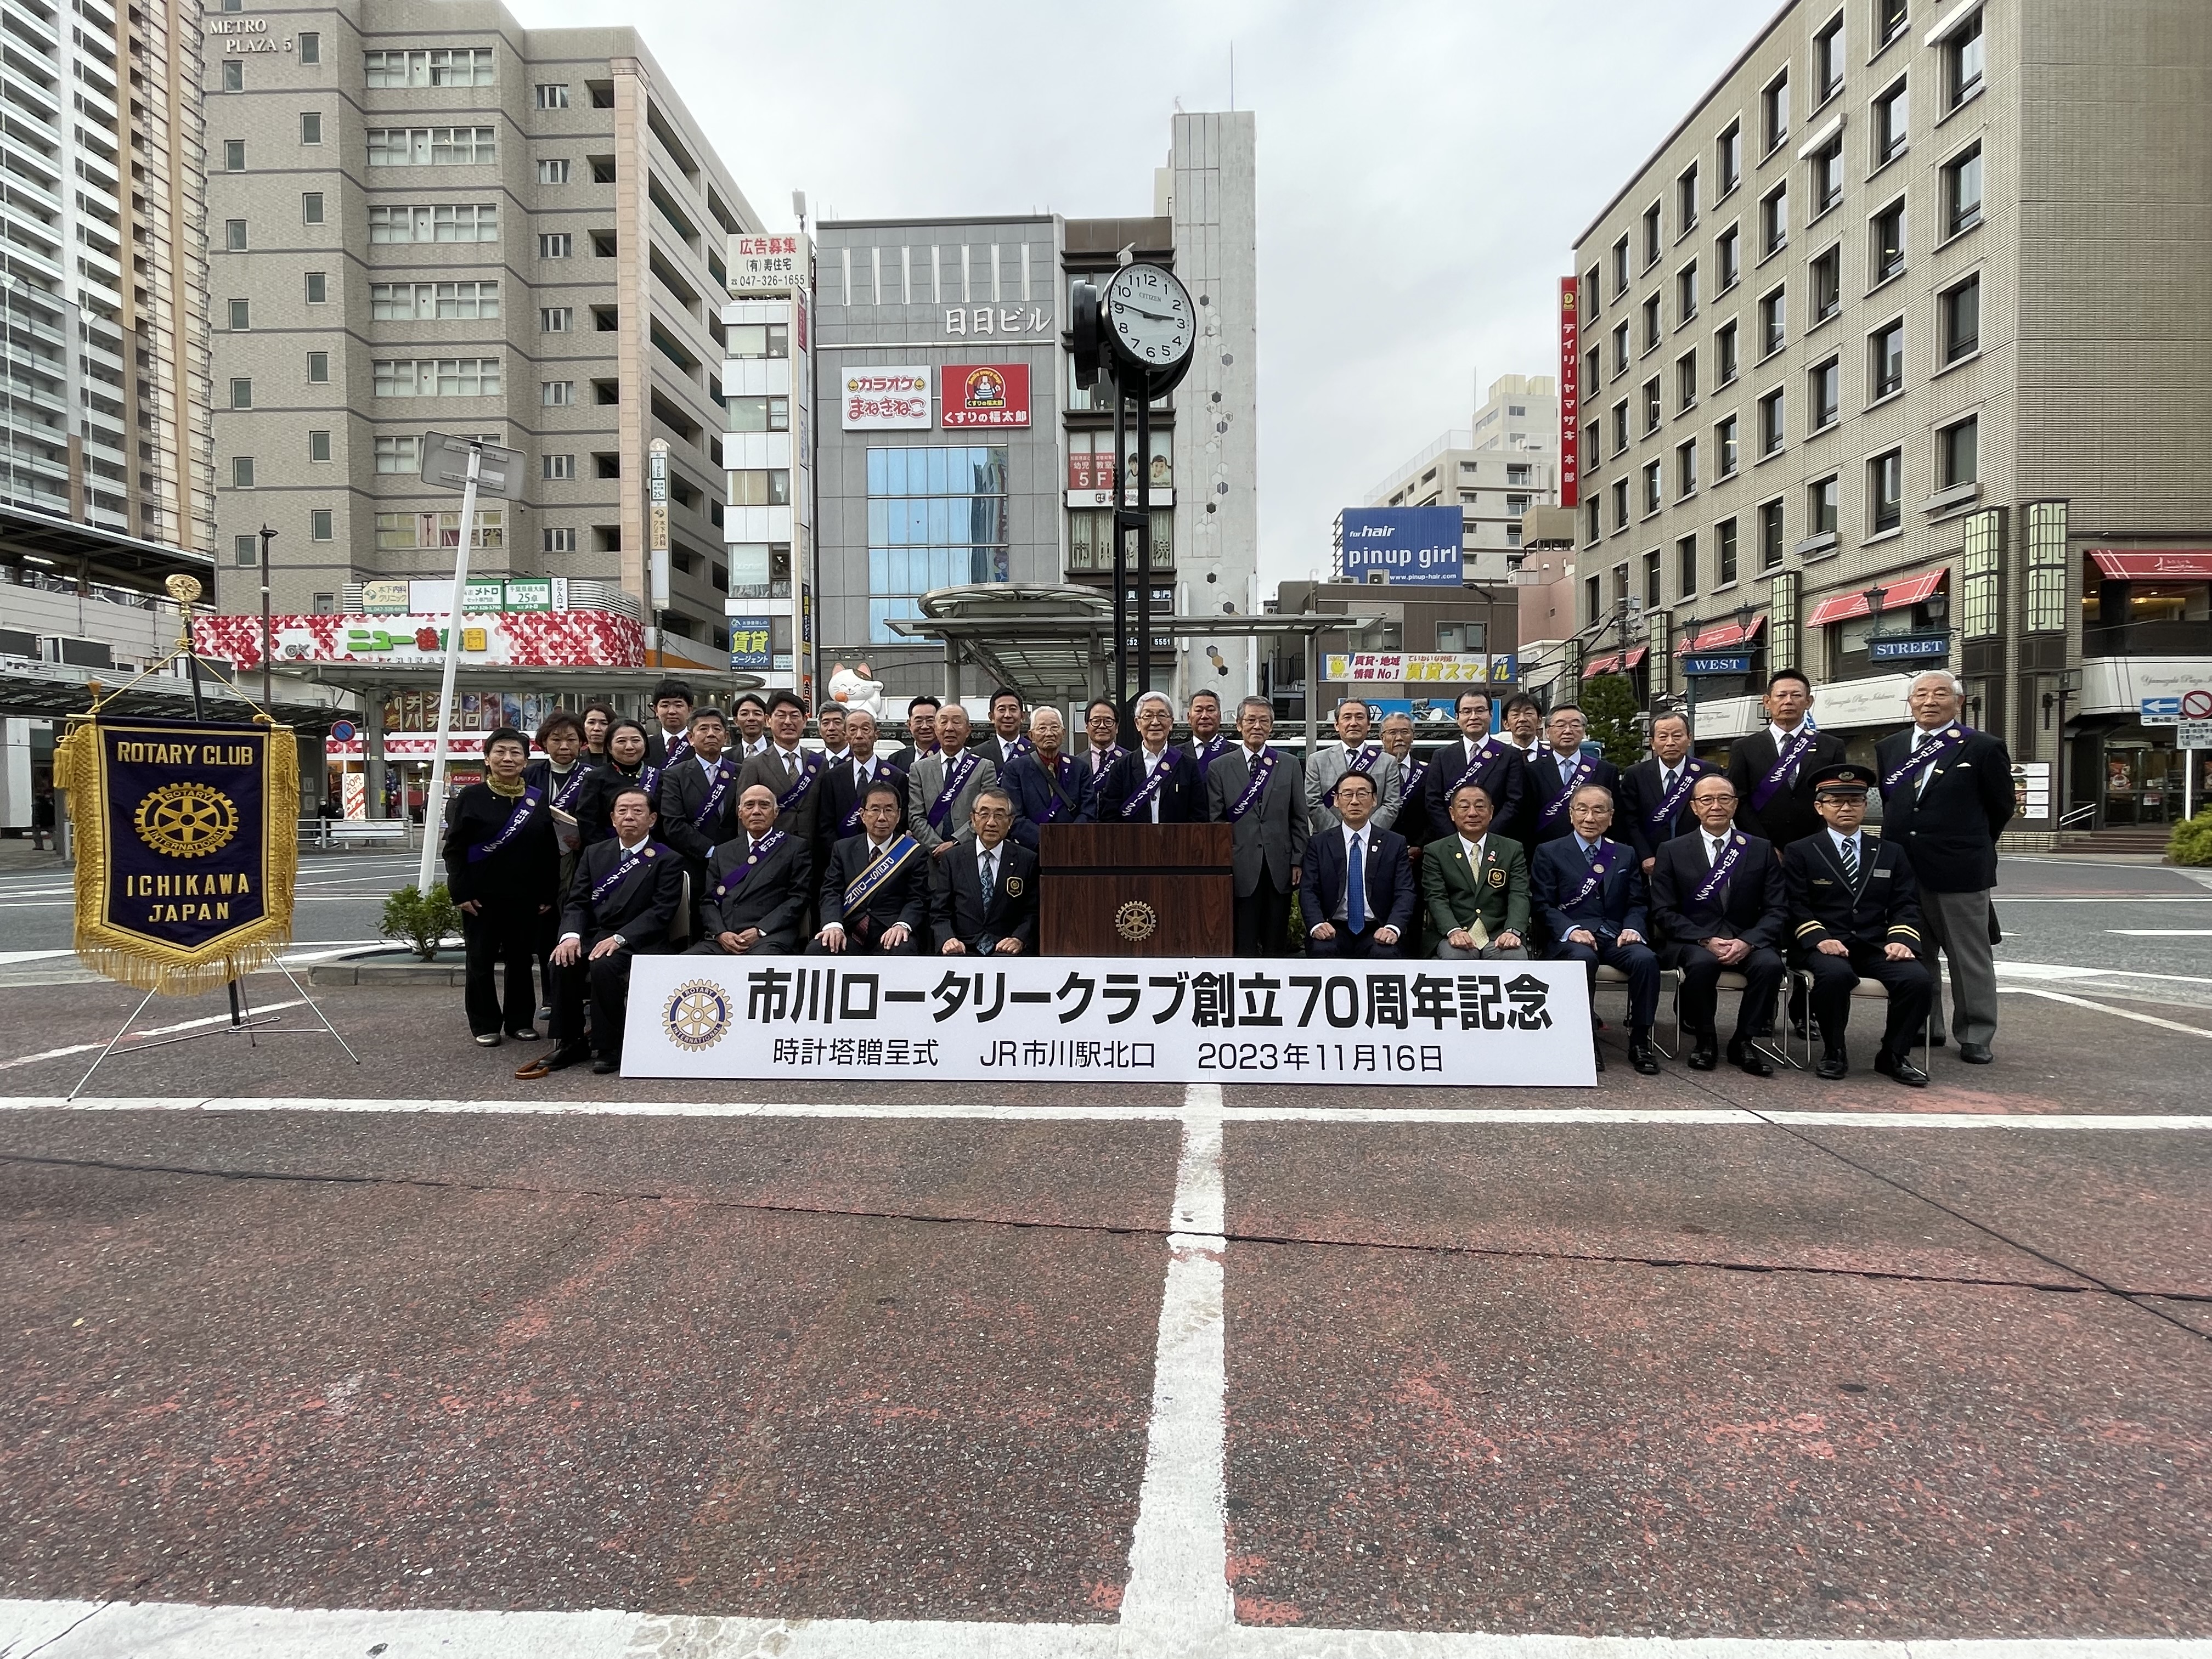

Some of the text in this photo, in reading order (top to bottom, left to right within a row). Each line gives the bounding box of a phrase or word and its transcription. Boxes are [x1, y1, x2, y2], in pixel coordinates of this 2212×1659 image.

[210, 19, 267, 35] METRO
[226, 38, 292, 53] PLAZA 5
[740, 236, 797, 255] 広告募集
[741, 274, 805, 286] 047-326-1655
[1129, 274, 1140, 288] 11
[1144, 273, 1158, 287] 12
[1118, 285, 1131, 298] 10
[1164, 284, 1168, 295] 1
[1139, 292, 1162, 303] CITIZEN
[1114, 303, 1125, 314] 9
[1172, 299, 1182, 311] 2
[946, 307, 1053, 336] 日日ビル
[1119, 322, 1129, 334] 8
[1176, 318, 1186, 330] 3
[1130, 337, 1141, 349] 7
[1172, 336, 1182, 347] 4
[1146, 347, 1156, 358] 6
[1161, 345, 1171, 357] 5
[859, 375, 915, 392] カラオケ
[847, 395, 927, 422] まねきねこ
[944, 409, 1028, 424] くすりの福太郎
[1564, 454, 1576, 483] 本部
[1079, 471, 1107, 487] 5F
[1361, 525, 1395, 538] hair
[1349, 545, 1457, 568] pinup girl
[1390, 573, 1457, 582] www.pinup-hair.com
[379, 594, 407, 602] クリニック
[475, 587, 499, 596] メトロ
[731, 630, 769, 654] 賃貸
[1876, 640, 1943, 656] STREET
[731, 655, 769, 664] エージェント
[1355, 655, 1401, 666] 賃貸・地域
[1695, 659, 1740, 670] WEST
[1354, 668, 1399, 680] 情報 No.1
[117, 742, 254, 766] ROTARY CLUB
[165, 791, 213, 800] ROTARY
[1233, 769, 1268, 814] 市川ロータリークラブ
[149, 828, 227, 851] INTERNATIONAL
[1695, 848, 1740, 901] 市川ロータリークラブ
[126, 873, 250, 897] ICHIKAWA
[148, 902, 229, 923] JAPAN
[685, 987, 714, 996] ROTARY
[747, 967, 1554, 1030] 市川ロータリークラブ創立70周年記念
[673, 1026, 721, 1044] INTERNATIONAL
[774, 1037, 1444, 1072] 時計塔贈呈式 JR市川駅北口 2023年11月16日
